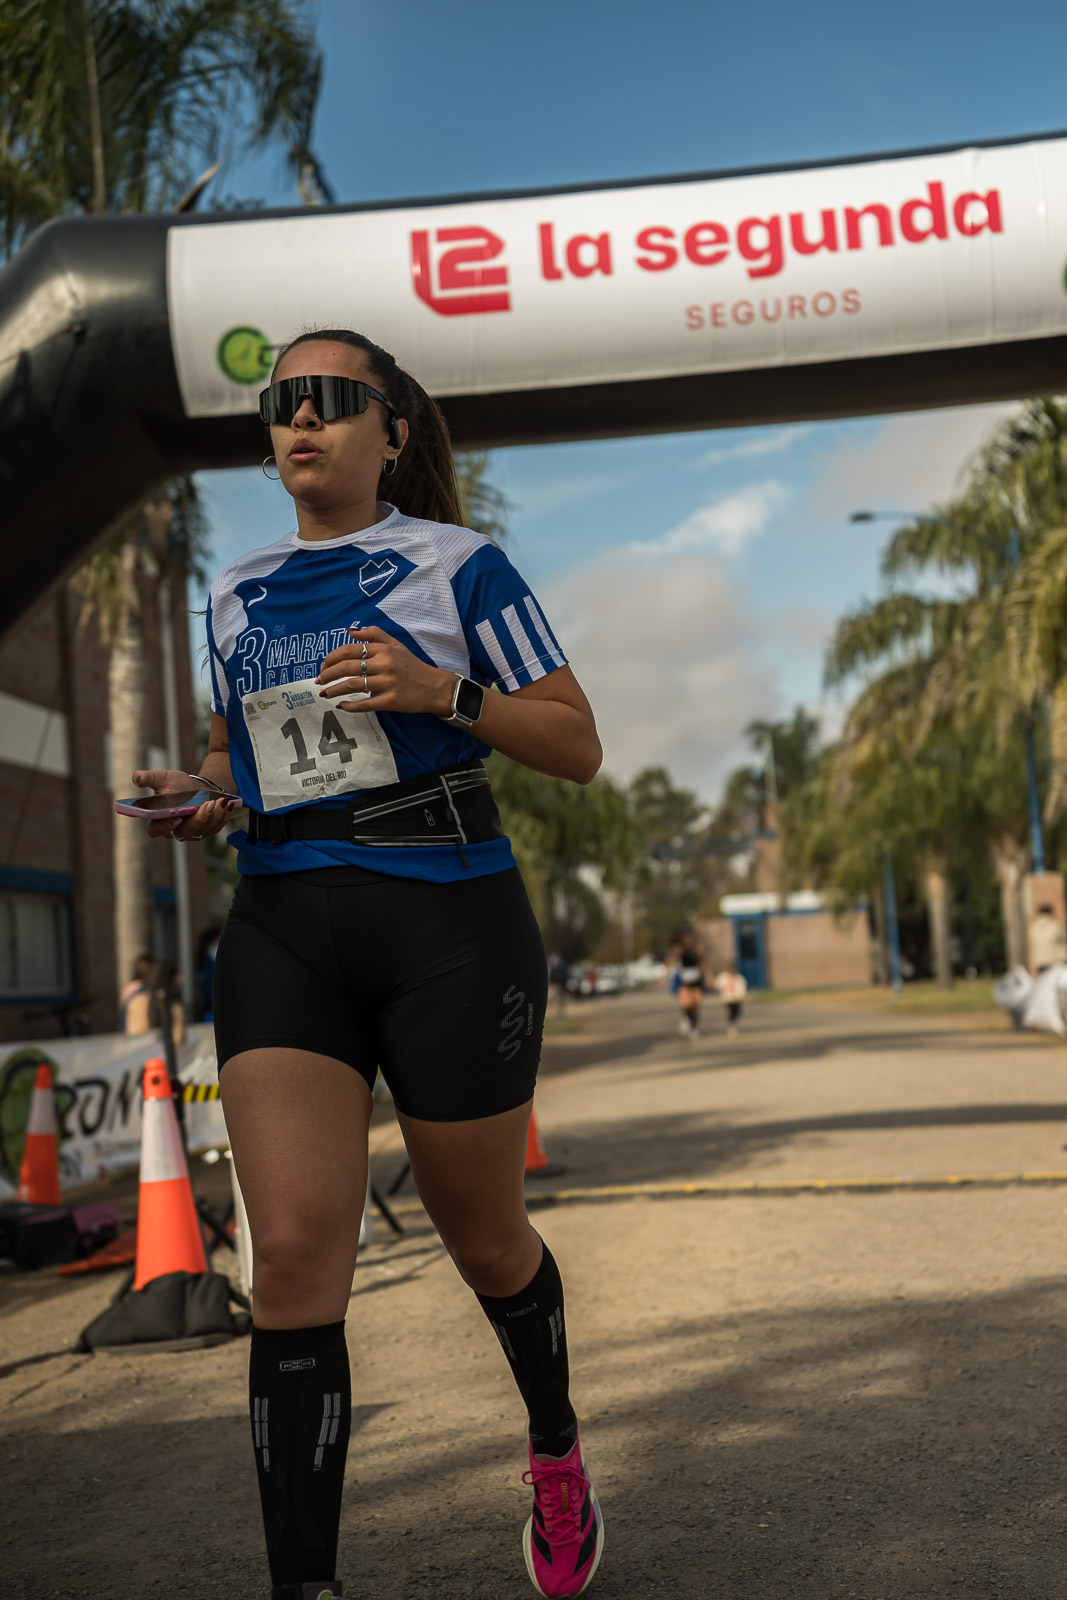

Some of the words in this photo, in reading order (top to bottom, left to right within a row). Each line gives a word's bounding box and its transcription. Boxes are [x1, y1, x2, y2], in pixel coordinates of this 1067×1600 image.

[537, 222, 615, 282] la
[633, 180, 1005, 280] segunda
[685, 288, 863, 331] SEGUROS
[266, 620, 370, 669] MARAT
[280, 710, 358, 776] 14
[301, 774, 325, 788] VICTORIA
[325, 772, 338, 783] DEL
